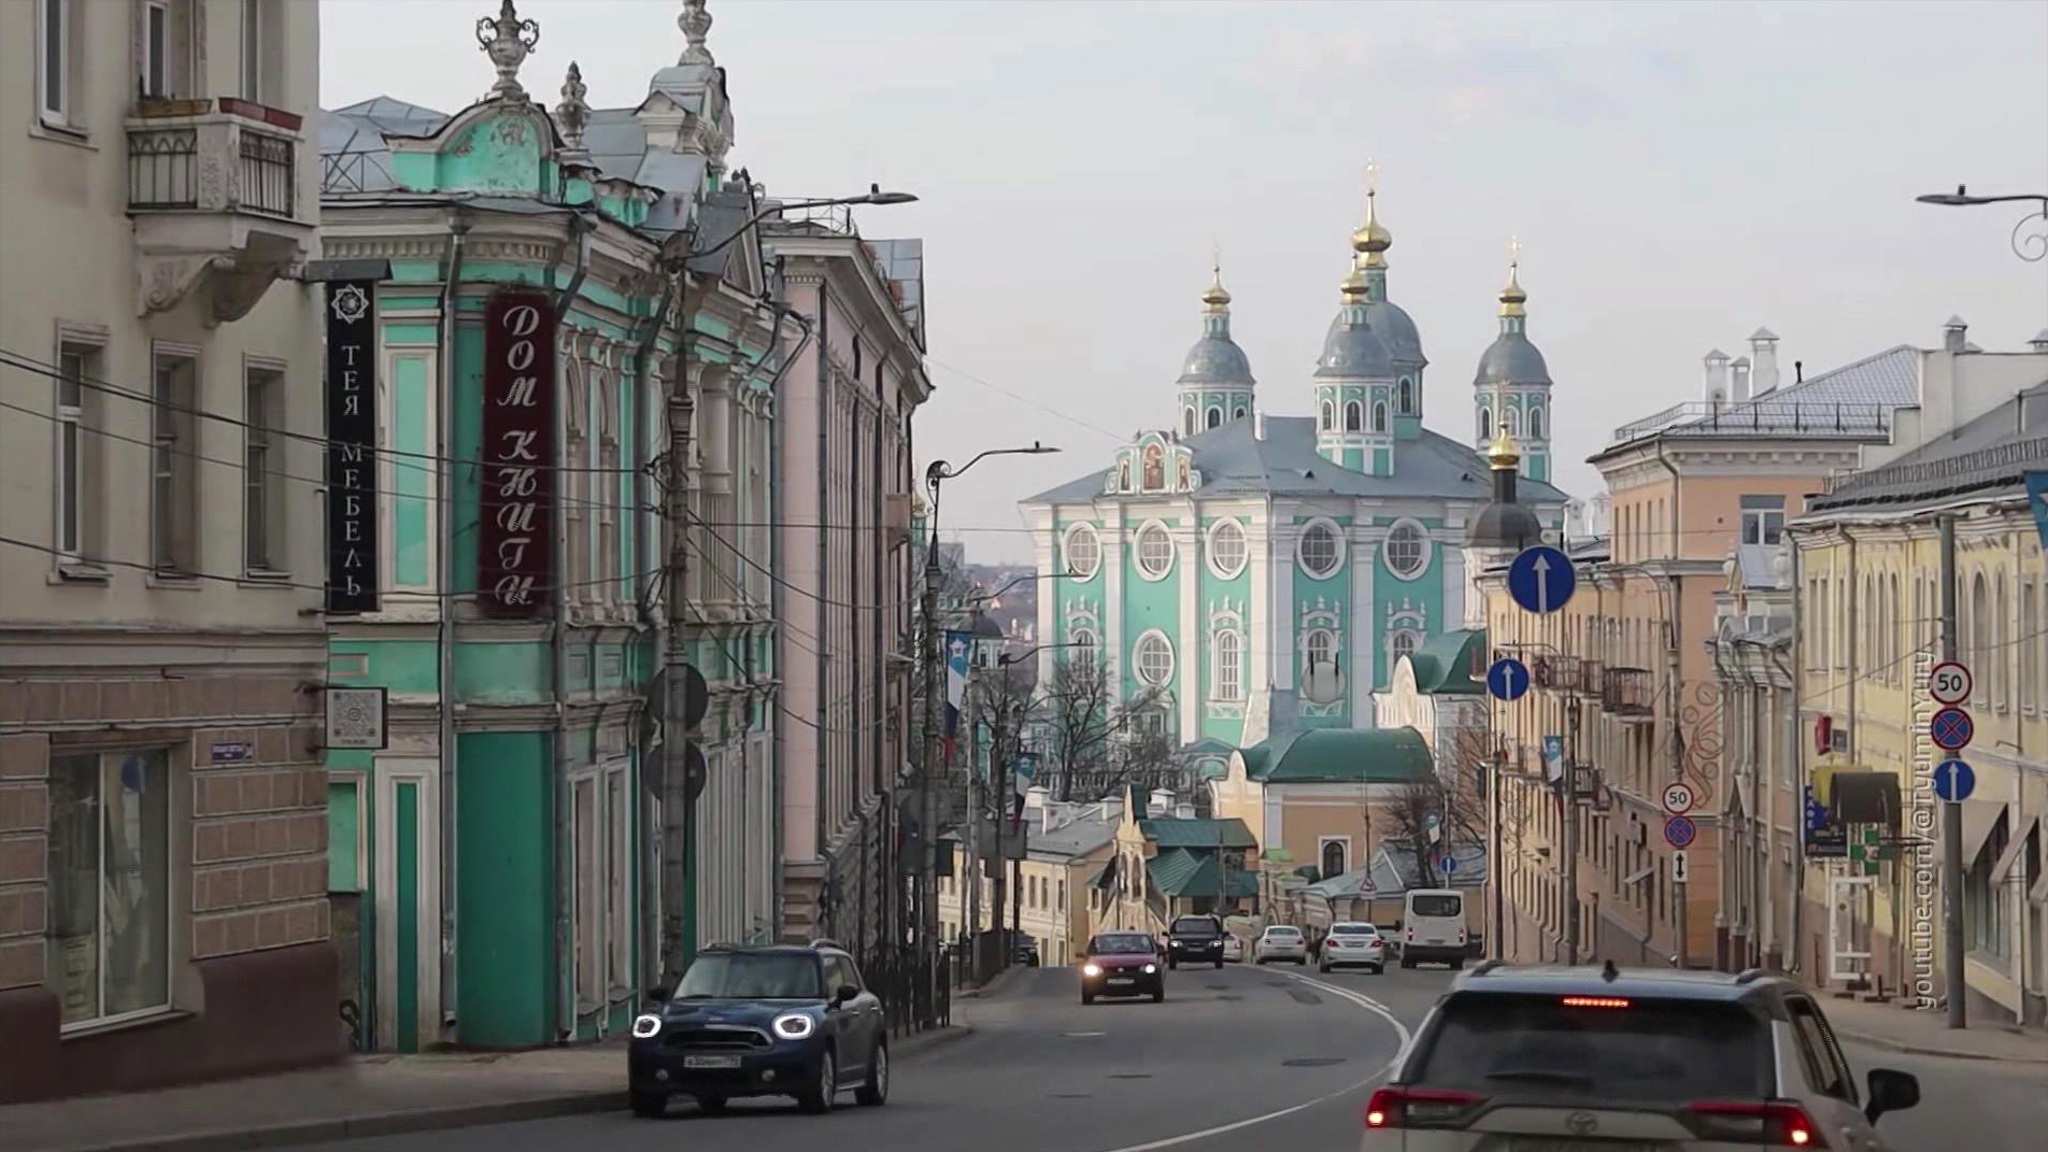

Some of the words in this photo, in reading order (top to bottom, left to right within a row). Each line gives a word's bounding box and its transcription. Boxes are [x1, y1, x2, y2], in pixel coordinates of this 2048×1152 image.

[341, 345, 361, 416] ТЕЯ
[496, 305, 541, 407] ДОМ
[341, 442, 362, 597] МЕБЕЛЬ
[494, 430, 539, 606] КНИГИ
[1937, 674, 1963, 693] 50
[1668, 791, 1688, 805] 50
